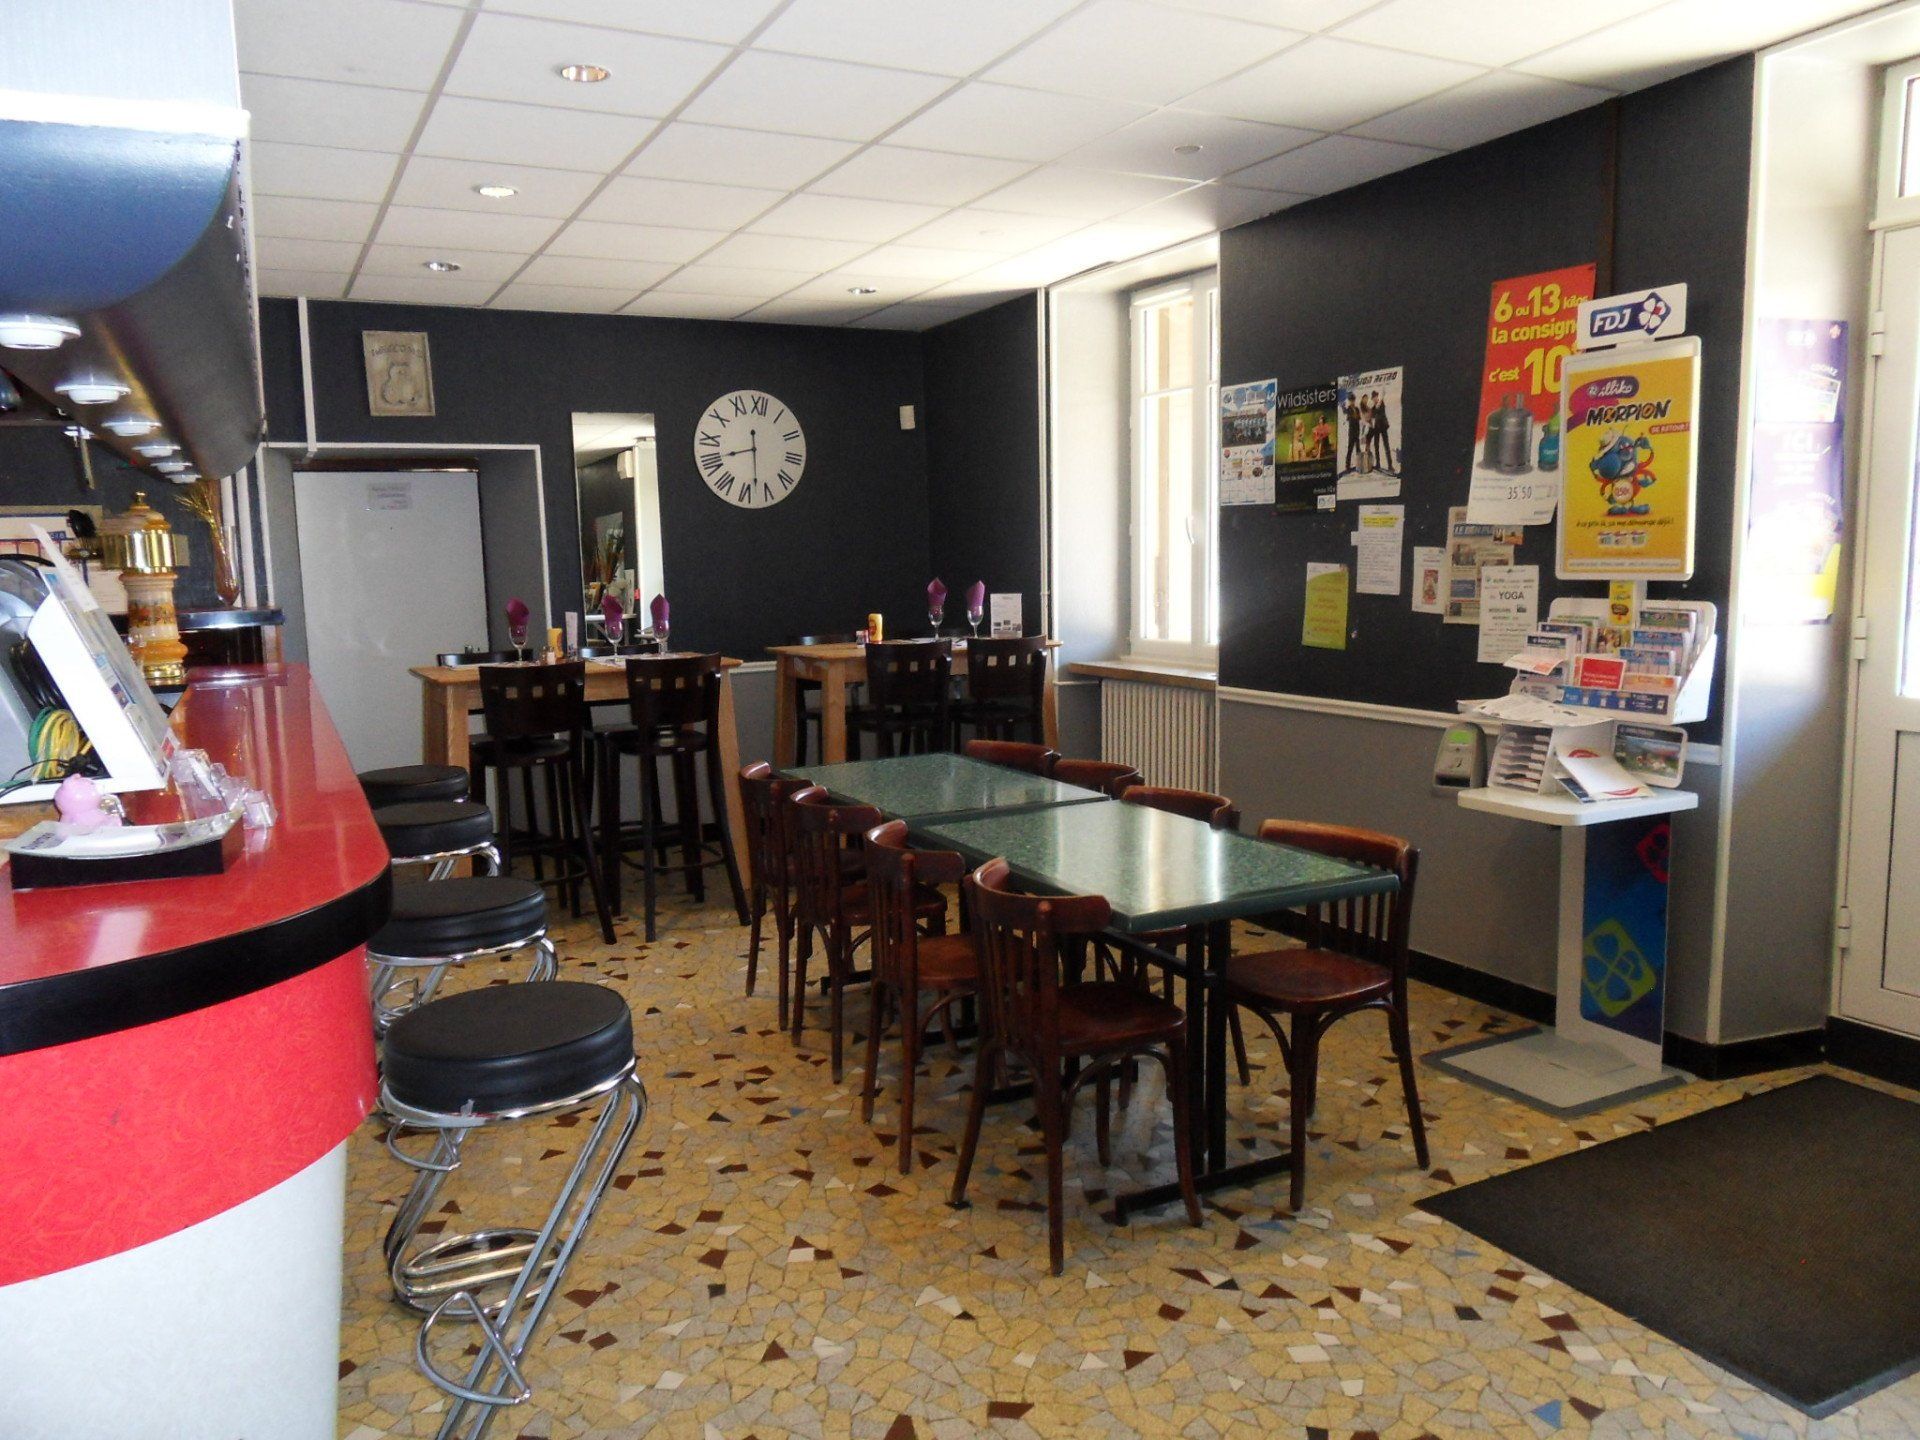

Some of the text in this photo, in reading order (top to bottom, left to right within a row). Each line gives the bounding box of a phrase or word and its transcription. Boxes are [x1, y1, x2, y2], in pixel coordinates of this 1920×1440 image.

[1494, 290, 1514, 323] 6
[1515, 306, 1530, 316] ou
[1527, 283, 1561, 318] 13
[1491, 318, 1577, 344] la consign
[1592, 309, 1632, 334] FDJ
[1524, 340, 1577, 396] 10
[1277, 388, 1337, 408] Wildsisters
[1586, 399, 1672, 427] MORPION
[1498, 591, 1525, 600] YOGA
